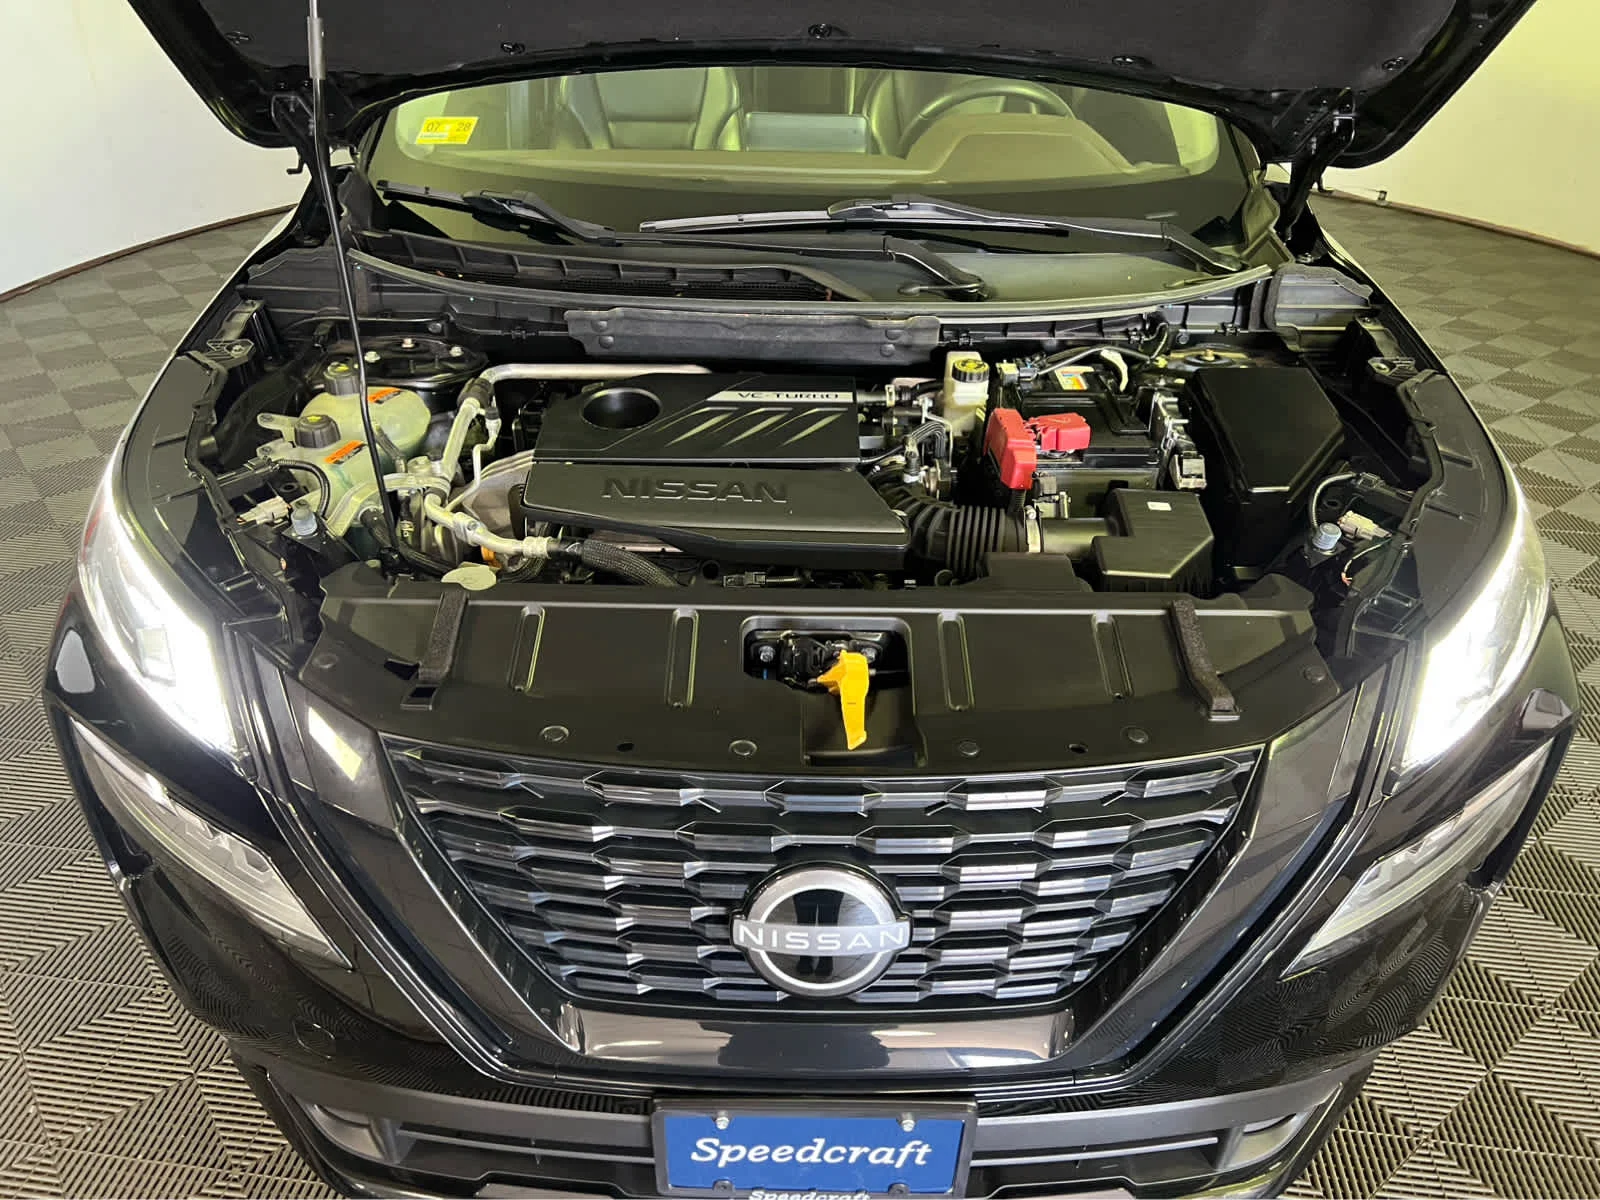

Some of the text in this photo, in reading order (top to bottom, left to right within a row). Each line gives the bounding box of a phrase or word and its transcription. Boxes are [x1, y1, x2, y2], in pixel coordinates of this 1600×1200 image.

[426, 122, 472, 133] 07 28
[601, 477, 788, 503] NISSAN
[738, 925, 904, 951] NISSAN
[690, 1137, 933, 1168] Speedcraft
